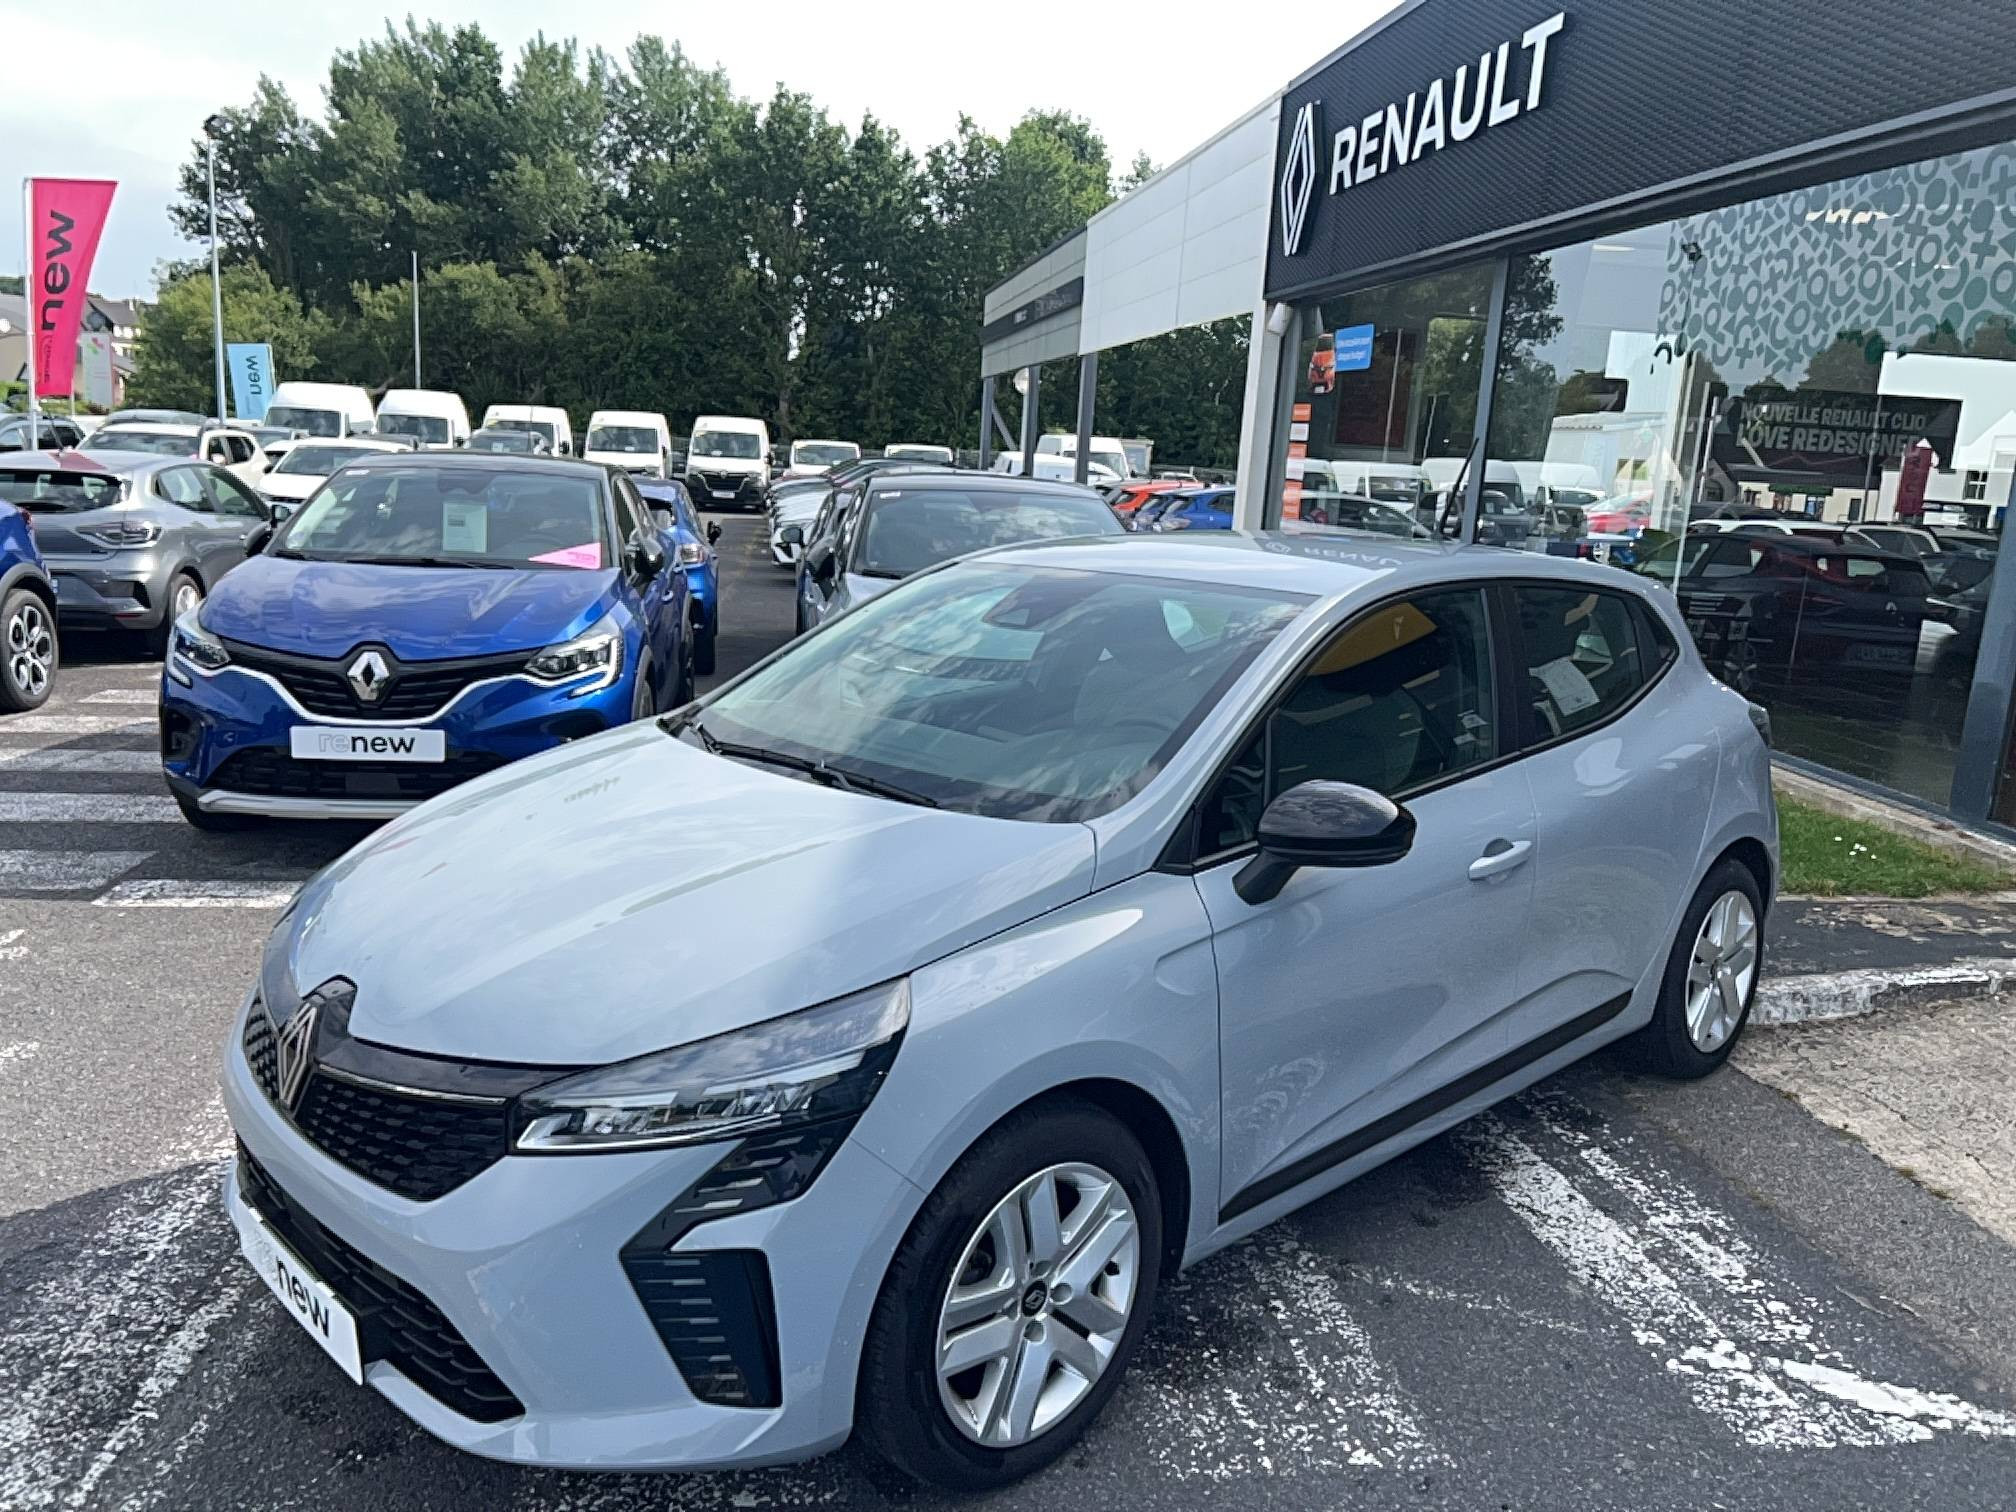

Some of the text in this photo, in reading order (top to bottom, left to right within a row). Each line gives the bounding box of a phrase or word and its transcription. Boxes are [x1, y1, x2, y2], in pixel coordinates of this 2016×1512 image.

[1329, 12, 1565, 196] RENAULT
[41, 209, 75, 331] new
[1741, 402, 1926, 432] NOUVELLE RENAULT CLIO
[1736, 421, 1791, 450] LOVE
[318, 734, 416, 754] renew
